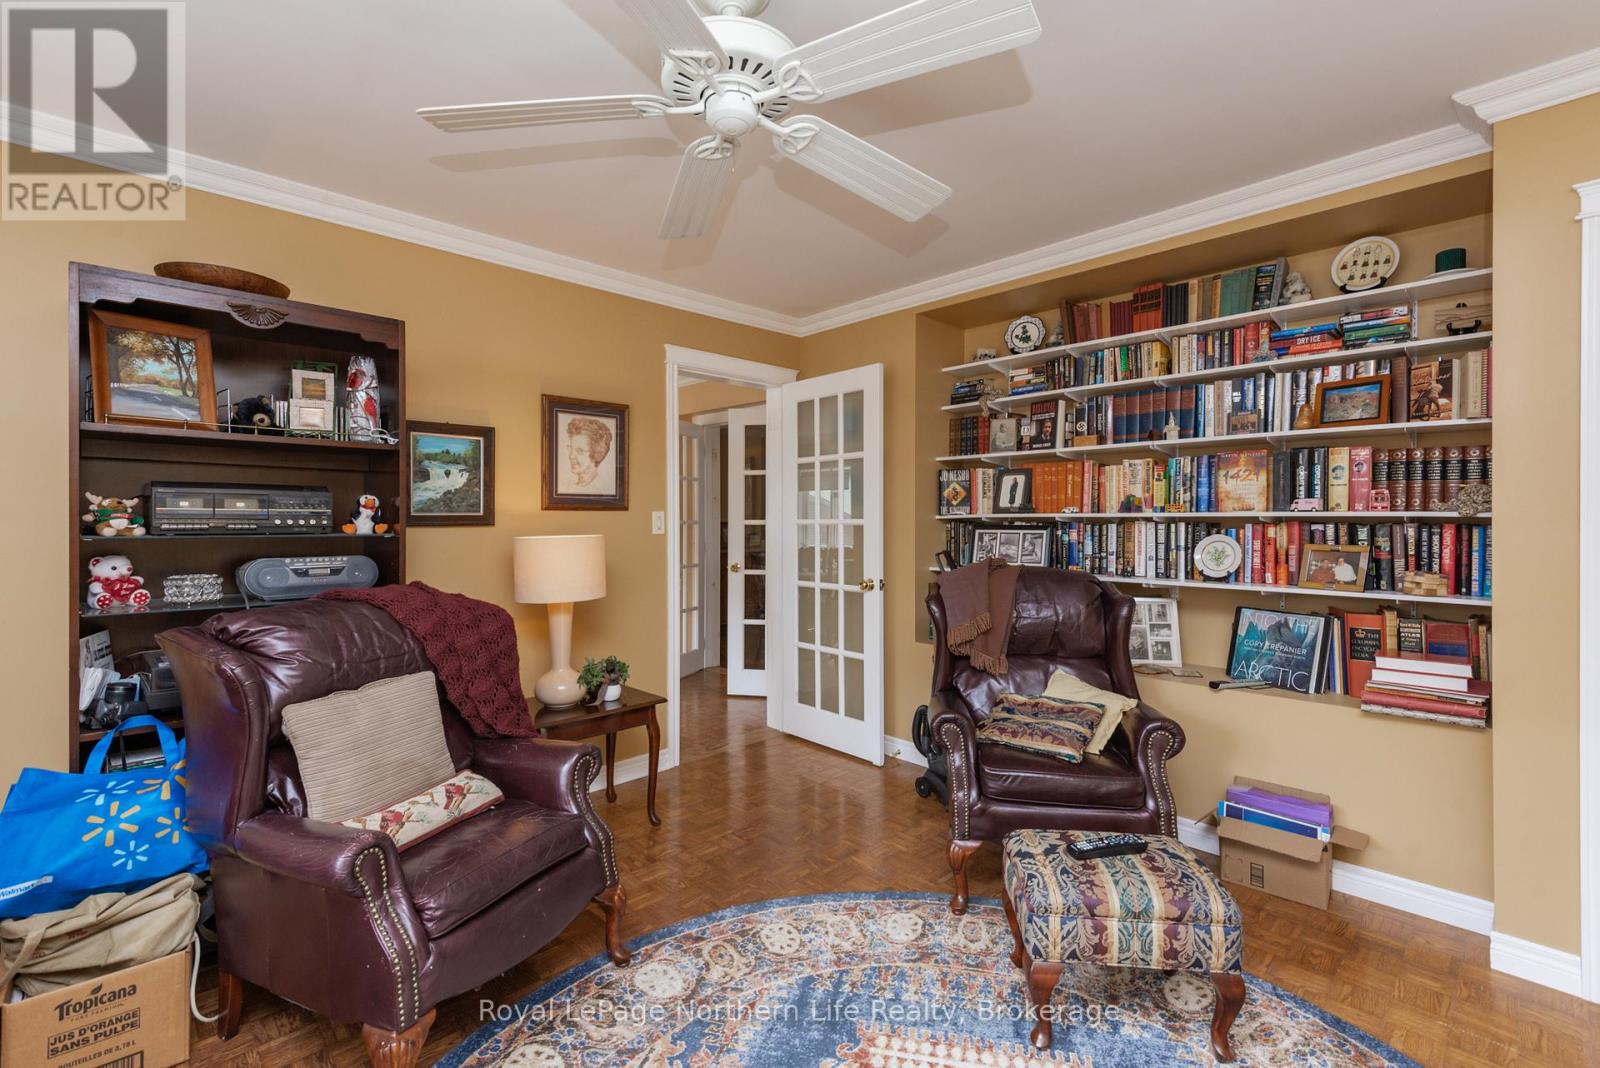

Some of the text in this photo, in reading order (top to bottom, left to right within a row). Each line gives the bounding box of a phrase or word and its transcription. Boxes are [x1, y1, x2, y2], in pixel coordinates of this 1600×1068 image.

[1297, 333, 1321, 345] DRY ICE
[940, 469, 951, 482] JO
[1222, 466, 1260, 484] 1421
[1432, 535, 1440, 553] SHOW
[1432, 558, 1440, 574] FORC
[1244, 639, 1264, 649] CORY
[1234, 659, 1310, 692] ARCTIC
[54, 984, 137, 1022] Tropicana
[50, 1010, 139, 1047] JUS D'ORANGE
[49, 1020, 139, 1058] SANS PULPE
